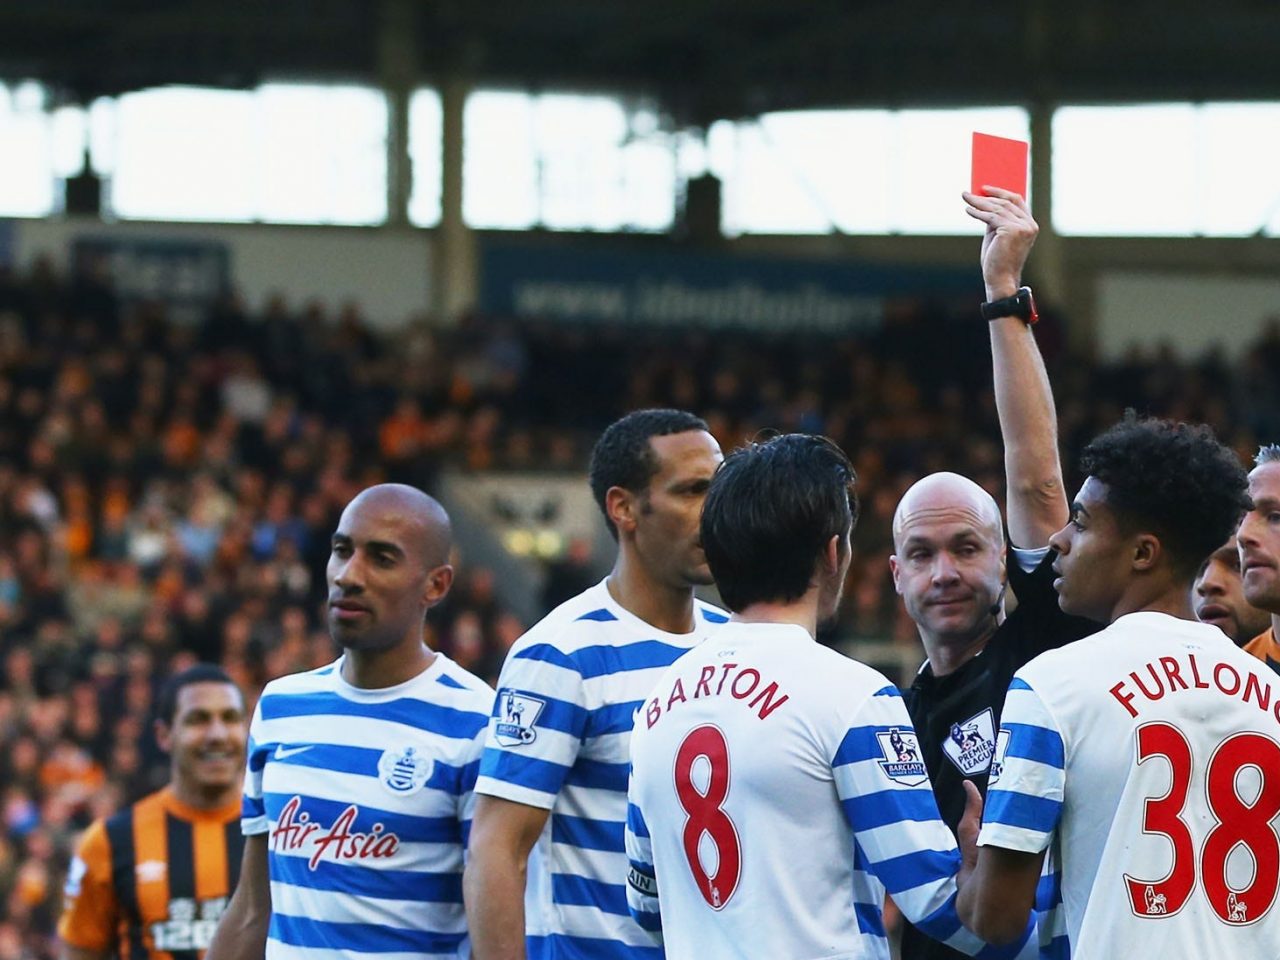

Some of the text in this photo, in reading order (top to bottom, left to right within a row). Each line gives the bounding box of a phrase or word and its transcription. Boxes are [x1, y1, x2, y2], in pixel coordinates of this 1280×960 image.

[646, 663, 789, 729] BARTON
[957, 740, 994, 763] PREMIER
[673, 723, 743, 912] 8
